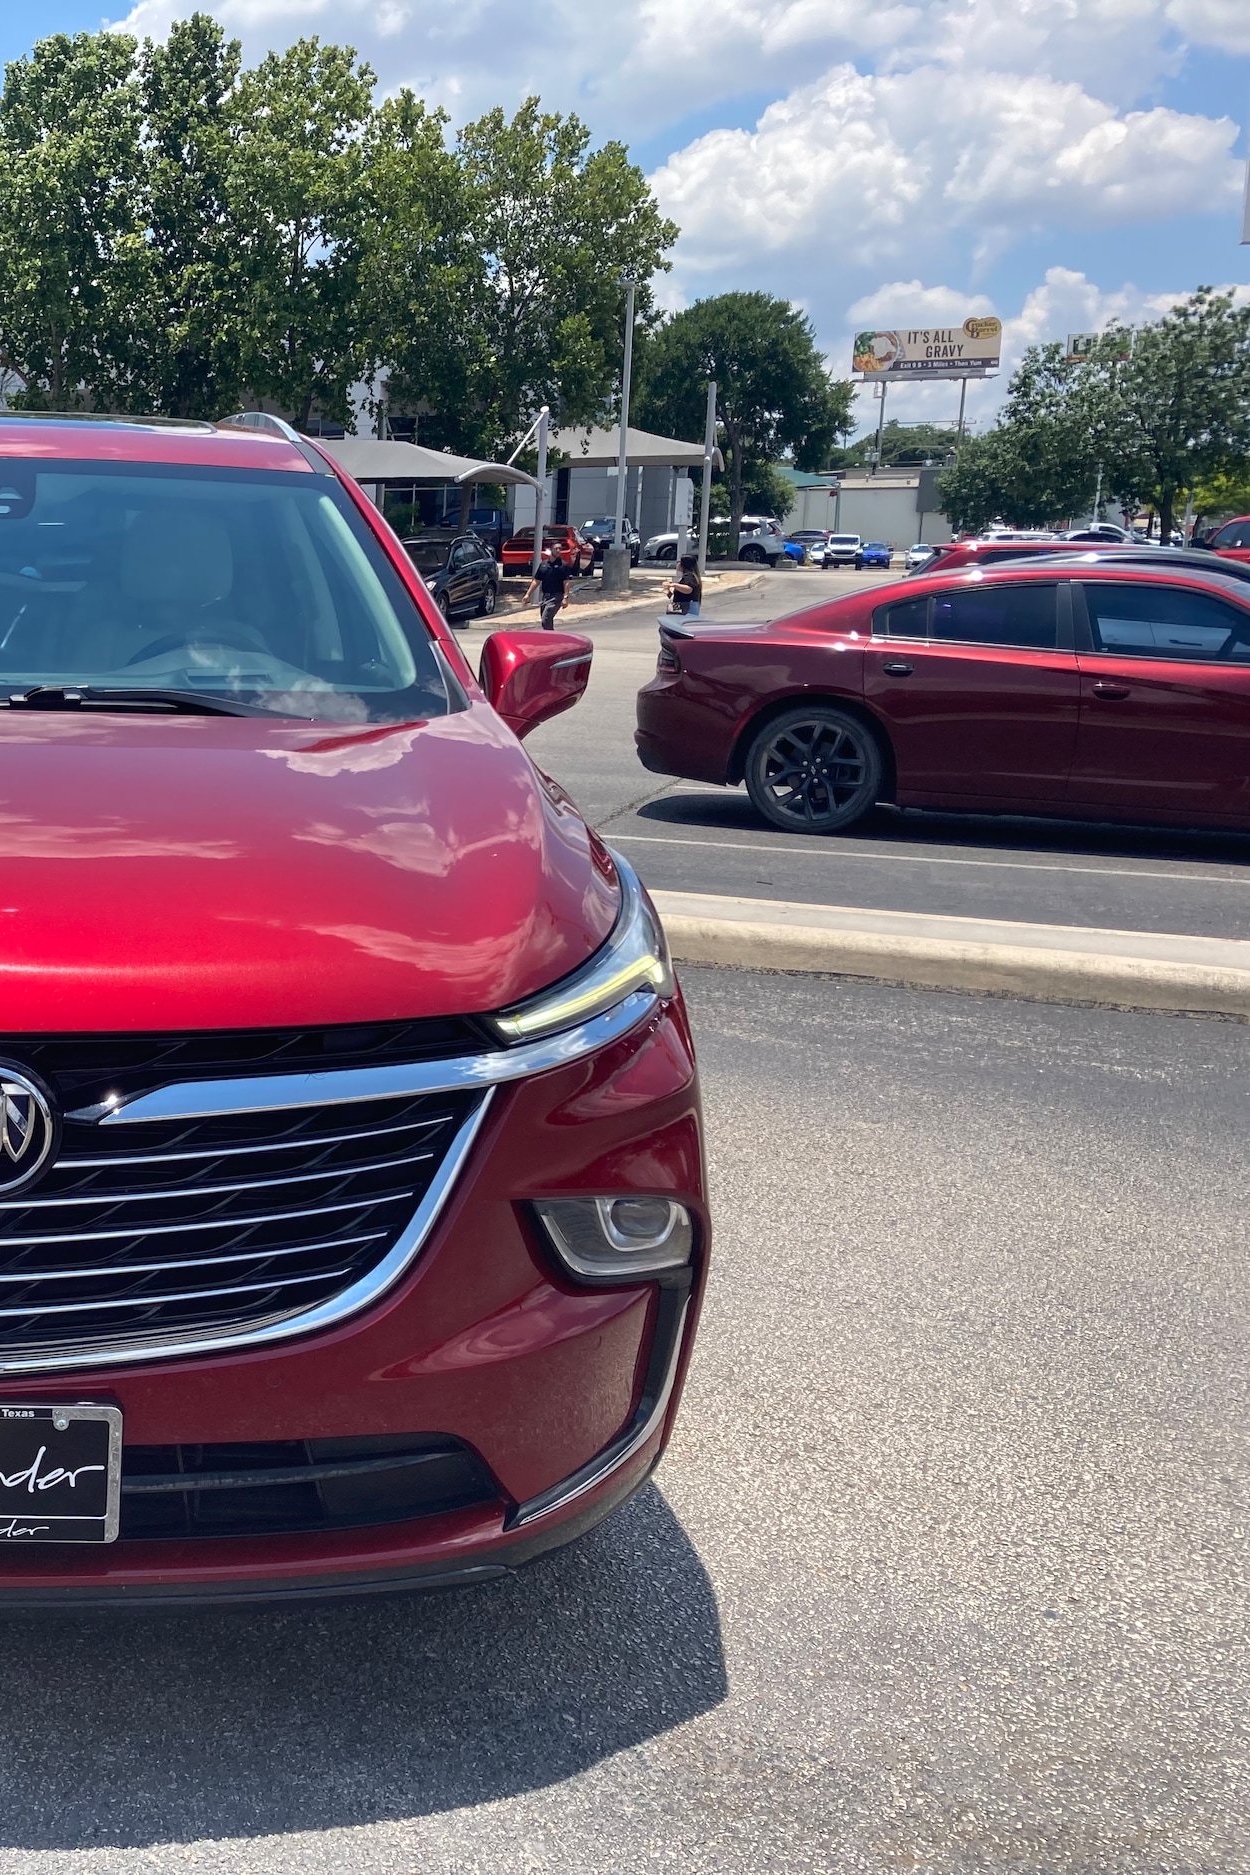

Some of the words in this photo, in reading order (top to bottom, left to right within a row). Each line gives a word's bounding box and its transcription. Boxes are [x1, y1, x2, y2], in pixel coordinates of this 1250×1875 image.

[907, 331, 930, 344] IT'S
[933, 330, 954, 343] ALL
[926, 344, 964, 358] GRAVY
[2, 1408, 35, 1418] Texas
